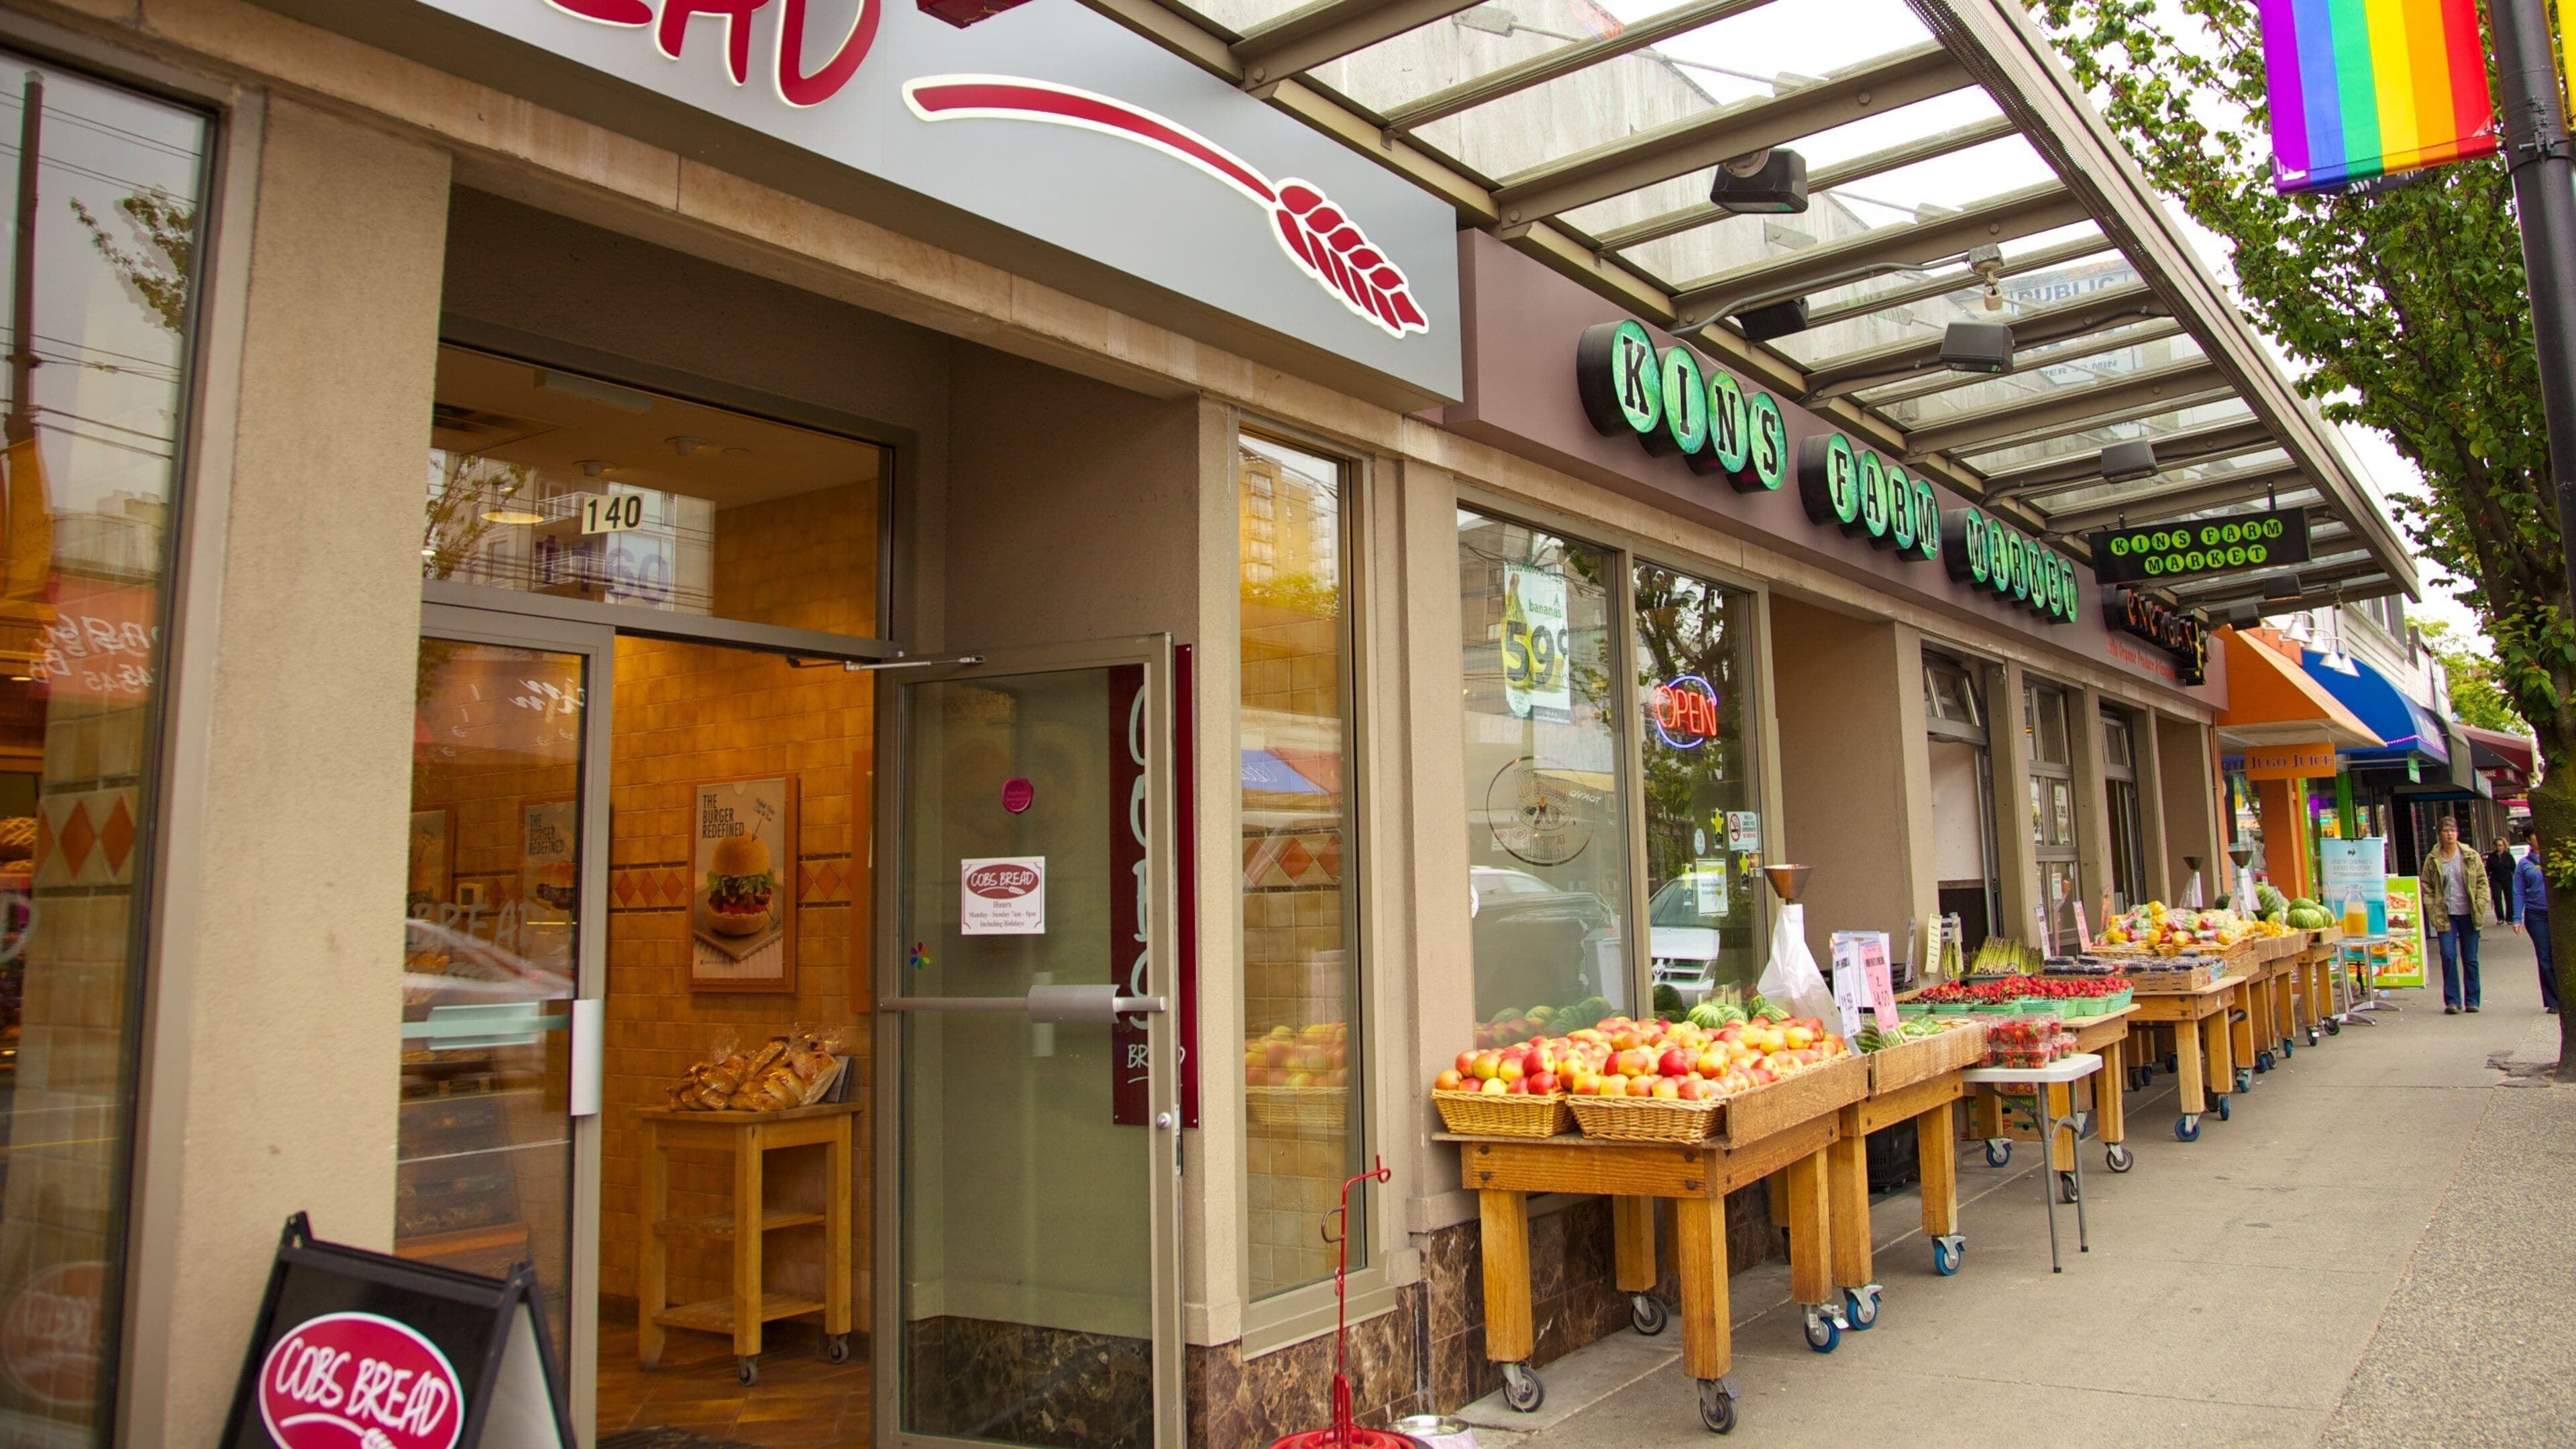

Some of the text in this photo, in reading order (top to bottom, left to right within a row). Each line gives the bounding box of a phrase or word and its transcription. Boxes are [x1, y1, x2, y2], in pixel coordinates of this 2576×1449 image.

[1622, 336, 1777, 477] KIN'S
[1832, 448, 1937, 549] FARM
[1967, 519, 2078, 614] MARKET
[588, 496, 642, 532] 140
[2115, 522, 2281, 552] KIN'S FARM
[2147, 546, 2263, 572] MARKET
[1529, 598, 1562, 619] bananas
[1656, 685, 1717, 736] OPEN
[2292, 753, 2332, 768] JUICE
[702, 794, 717, 809] THE
[702, 808, 735, 824] BURGER
[702, 822, 744, 839] REDEFINED
[971, 871, 1034, 887] COBS BREAD
[275, 1337, 450, 1437] COBS BREAD
